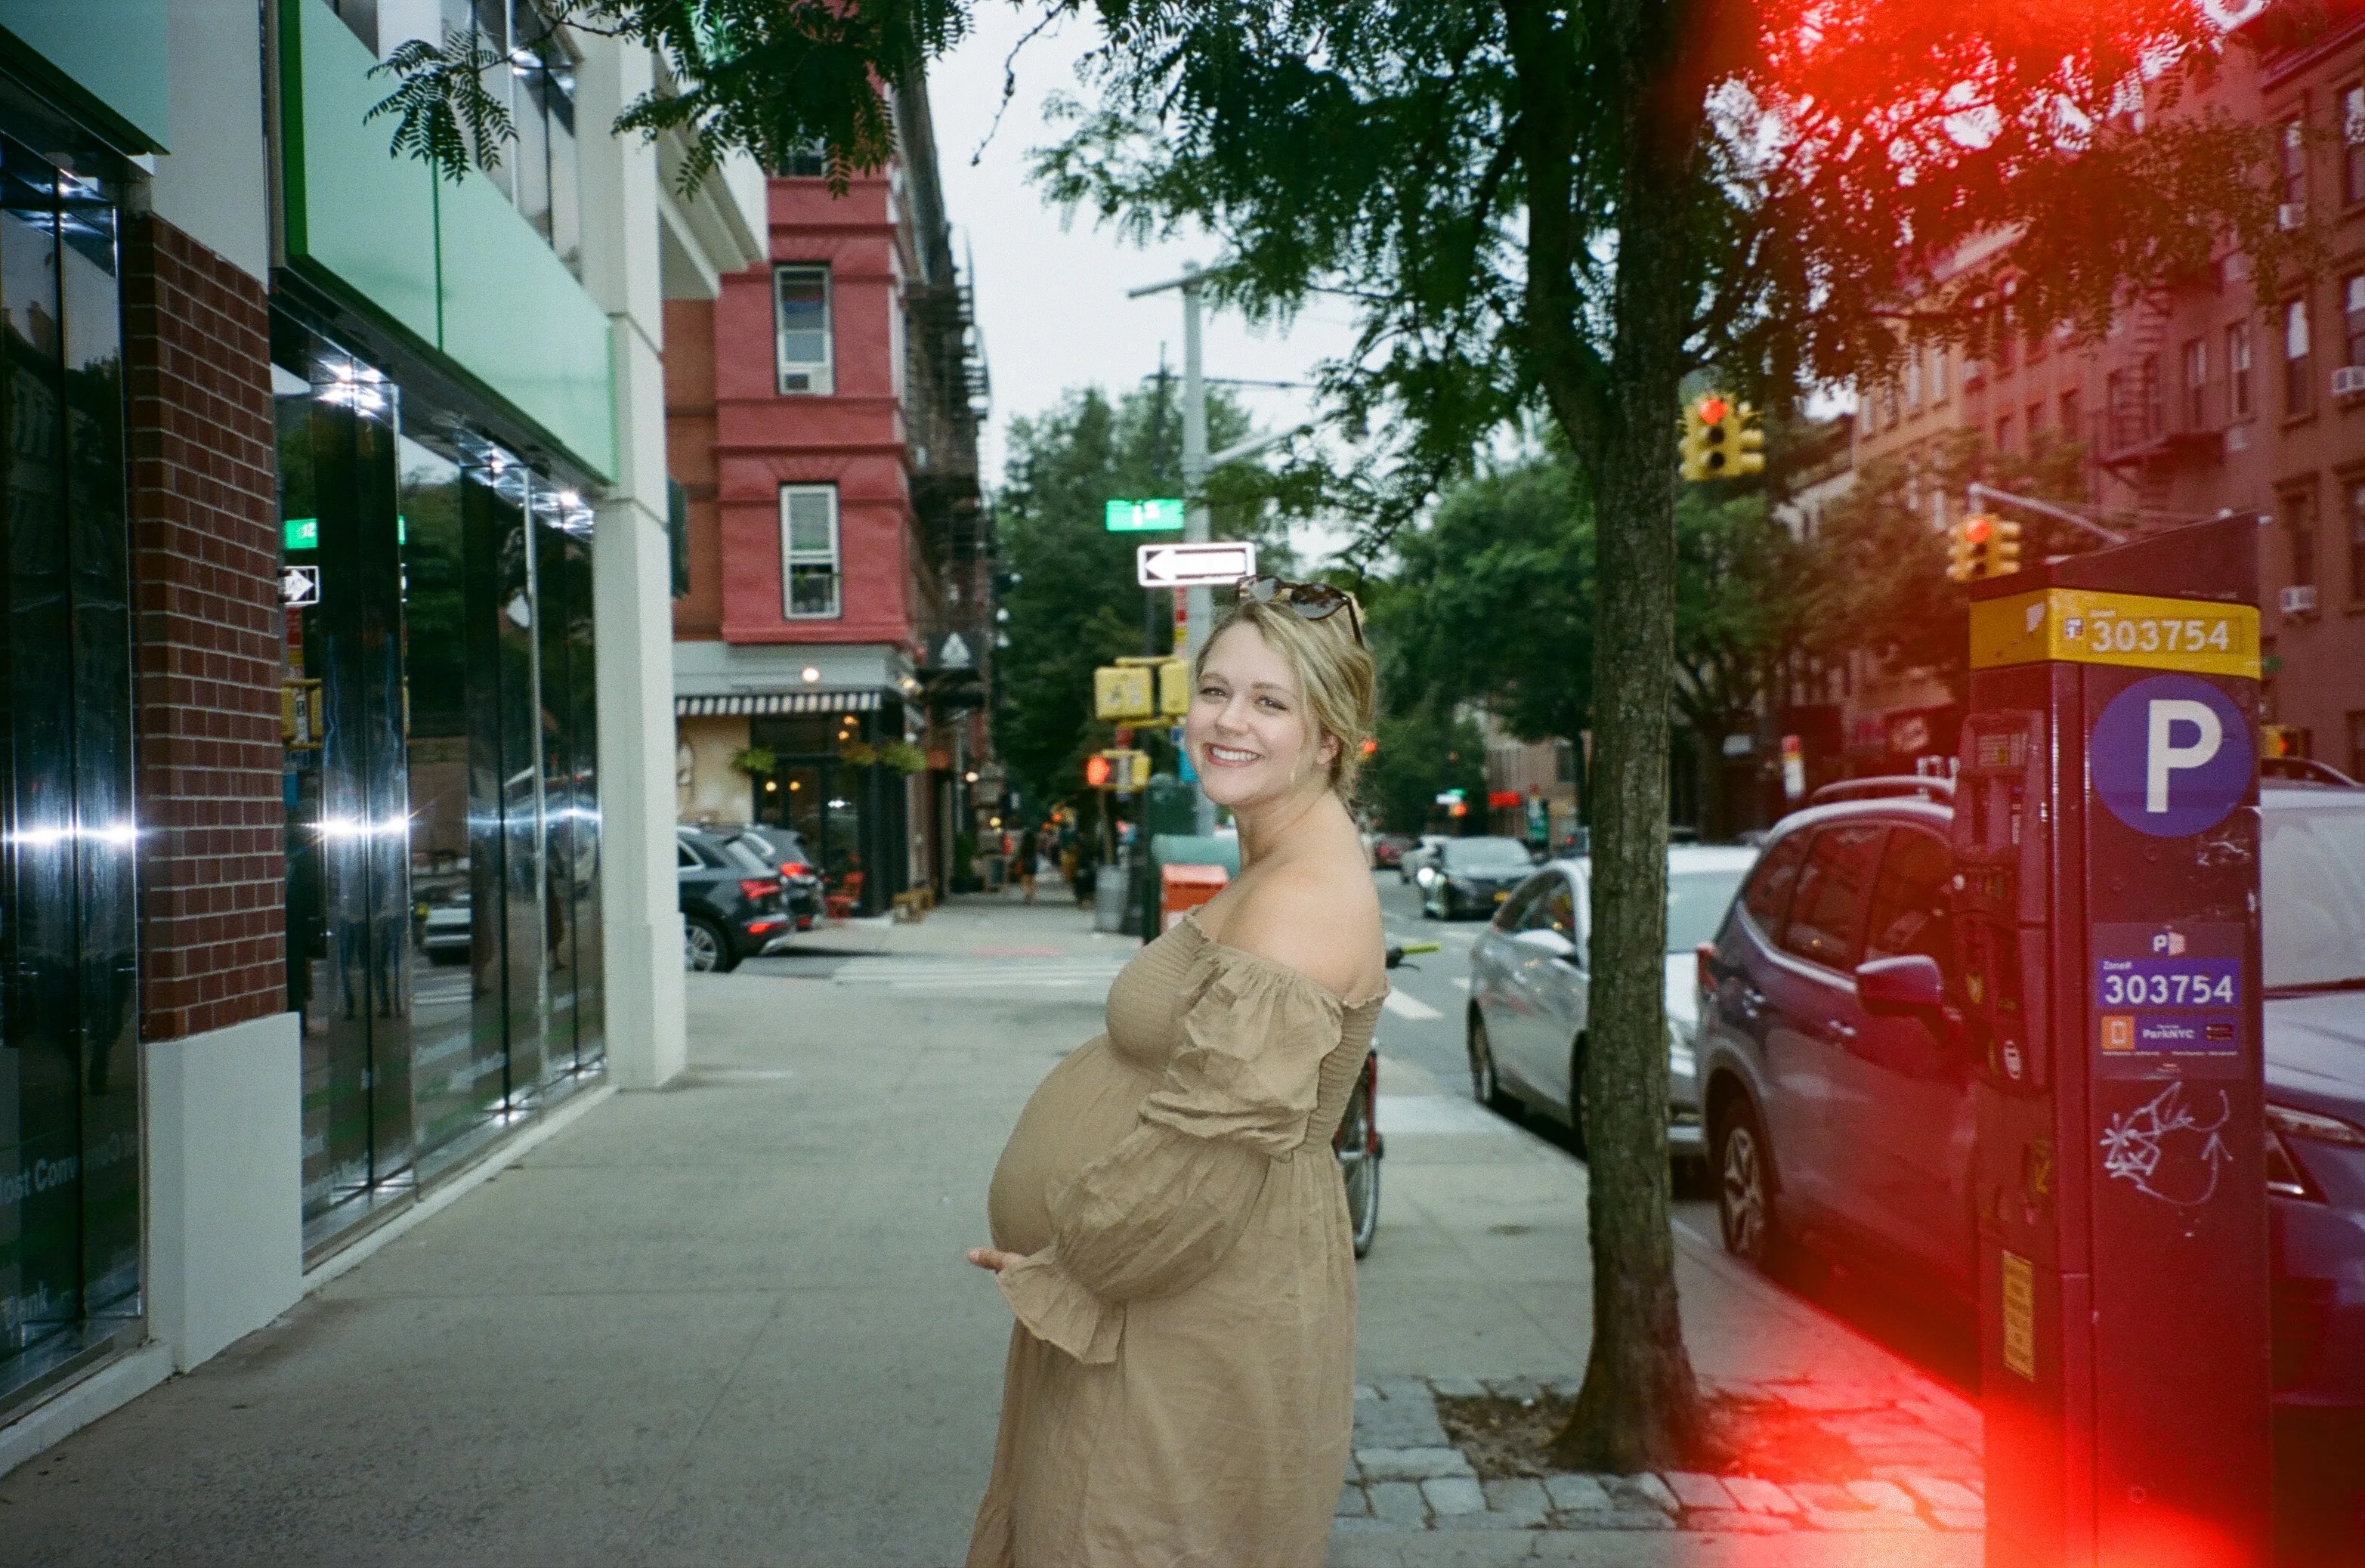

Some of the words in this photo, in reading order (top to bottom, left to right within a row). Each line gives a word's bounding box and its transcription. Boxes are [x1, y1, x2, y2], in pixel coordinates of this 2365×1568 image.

[2090, 620, 2230, 653] 303754
[2146, 699, 2223, 813] P
[2104, 975, 2234, 1004] 303754
[0, 1167, 31, 1206] ost
